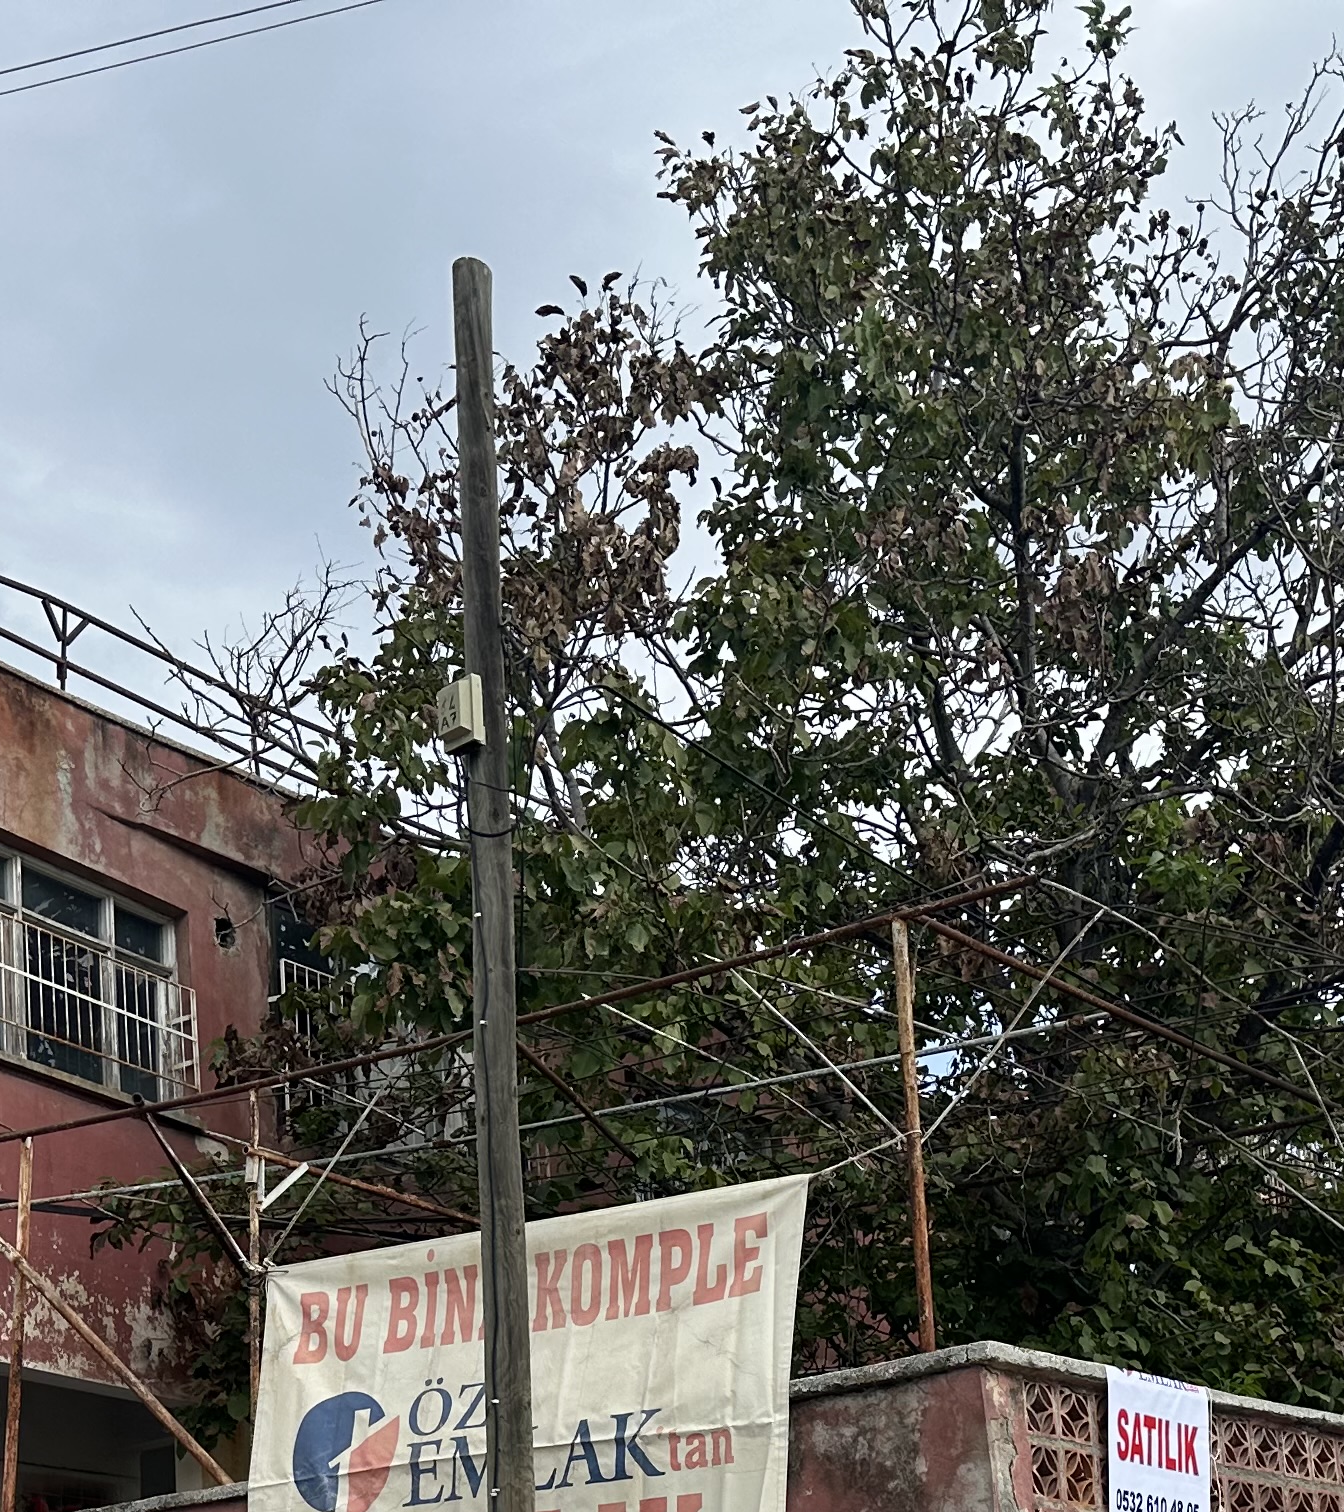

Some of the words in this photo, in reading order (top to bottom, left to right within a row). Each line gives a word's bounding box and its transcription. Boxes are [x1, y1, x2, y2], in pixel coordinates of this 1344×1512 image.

[292, 1283, 369, 1365] BU
[382, 1248, 485, 1355] BİN
[532, 1211, 769, 1333] KOMPLE
[1116, 1408, 1199, 1477] SATILIK
